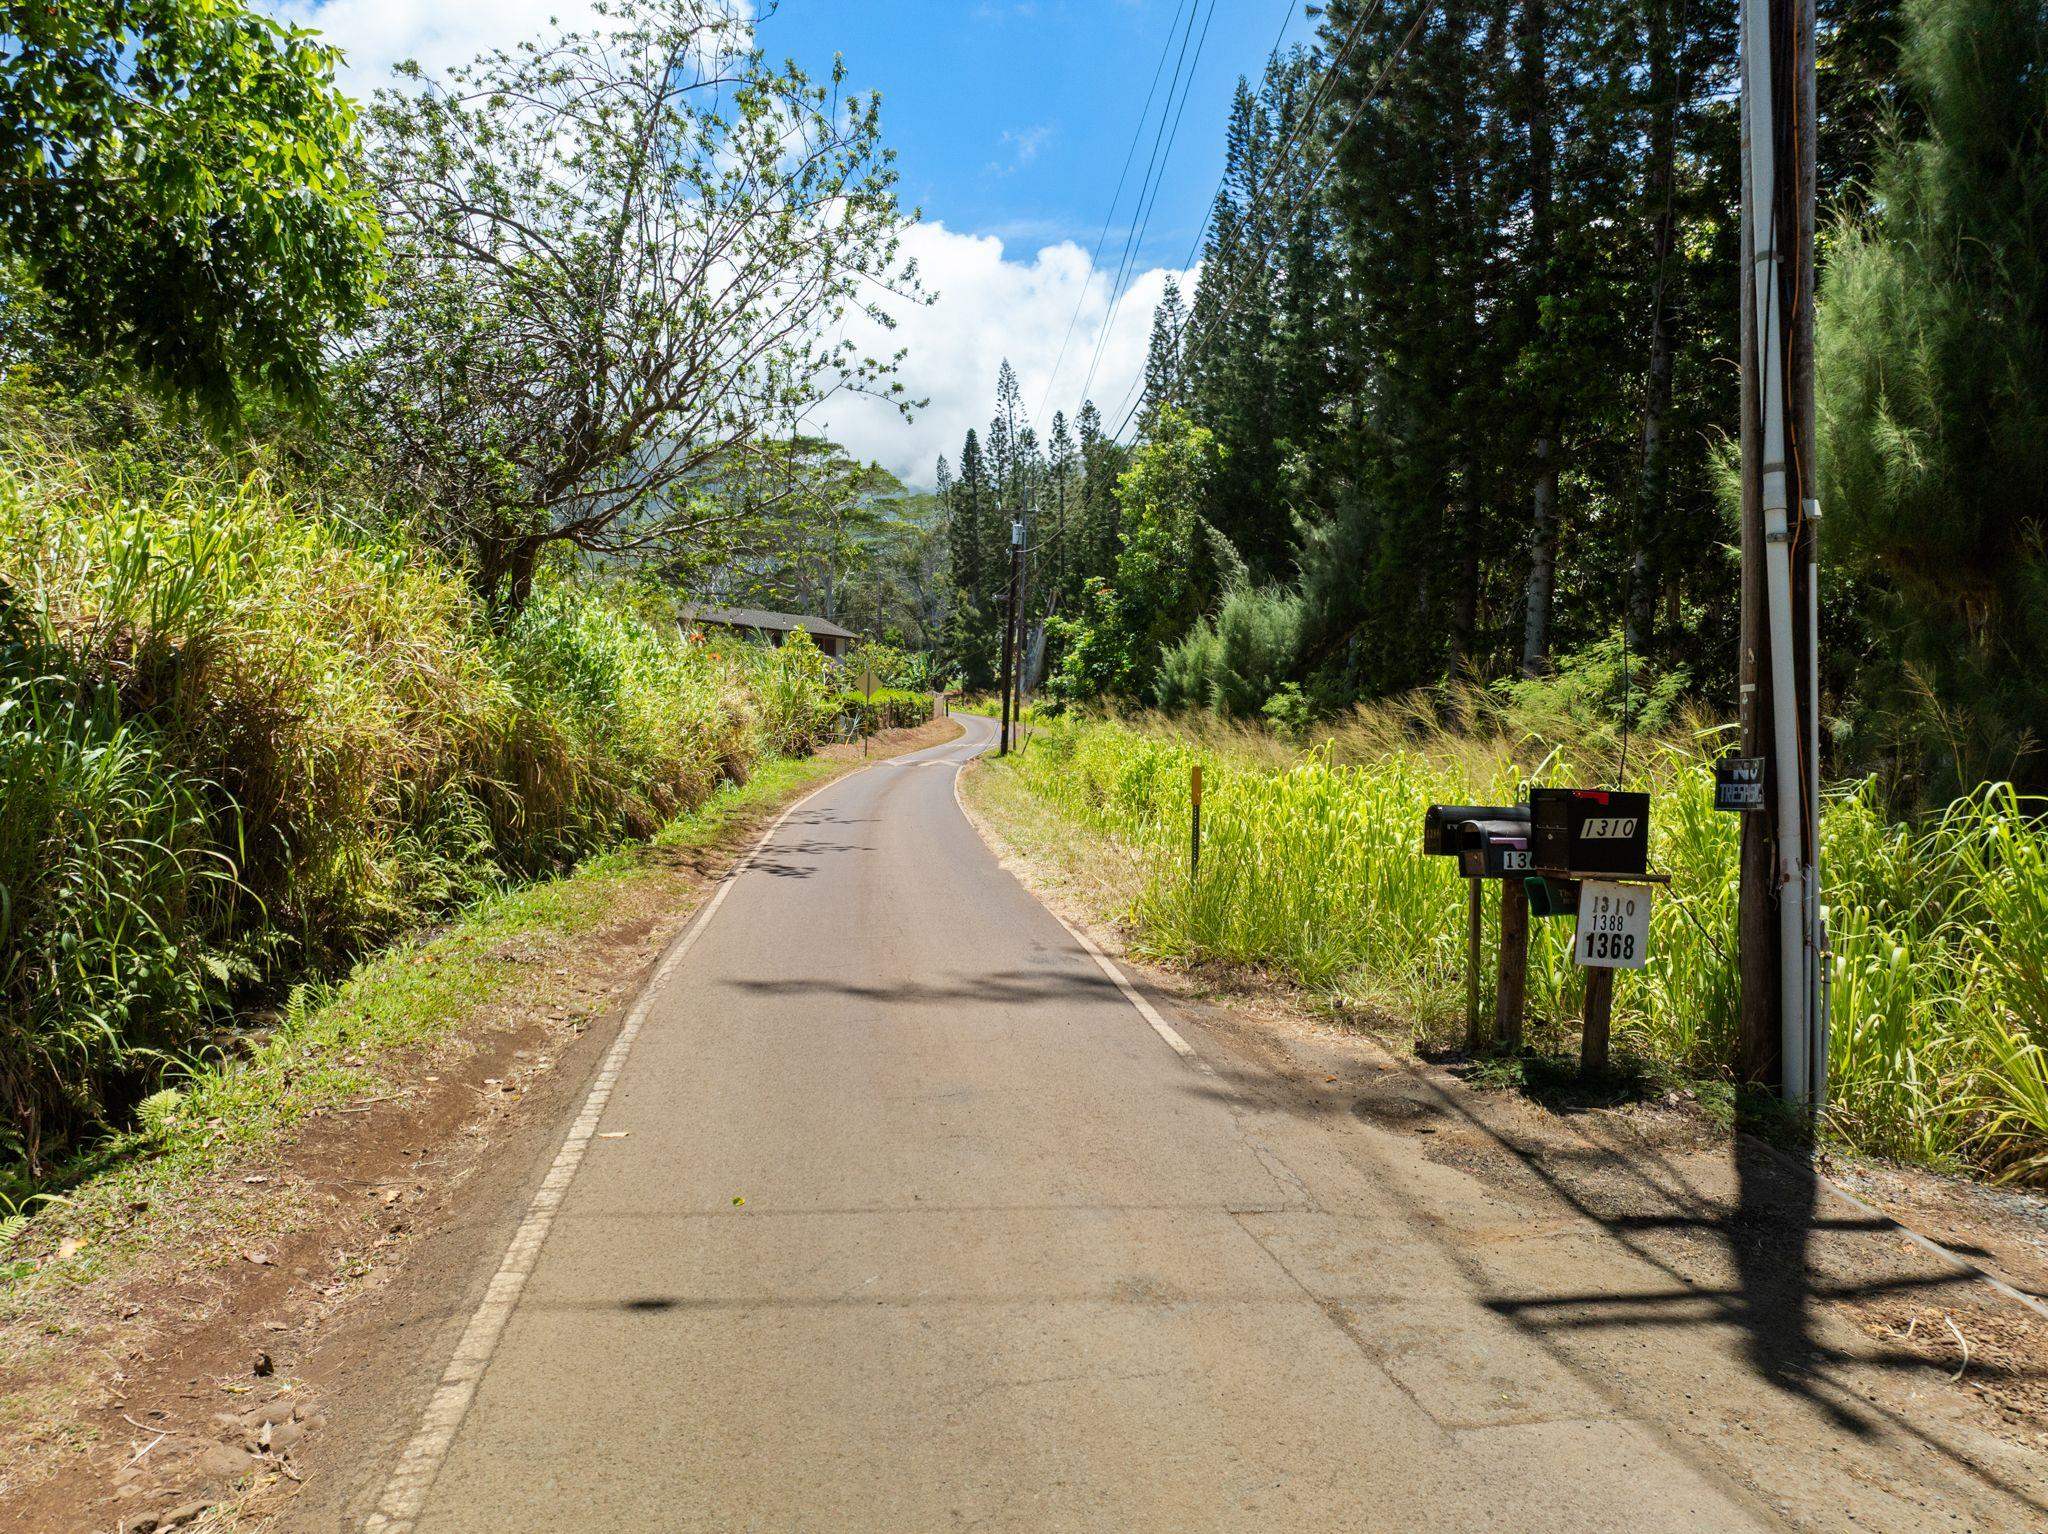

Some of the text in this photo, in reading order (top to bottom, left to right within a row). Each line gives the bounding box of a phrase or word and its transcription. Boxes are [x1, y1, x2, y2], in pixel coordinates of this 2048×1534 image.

[1586, 819, 1634, 837] 1310
[1592, 896, 1635, 917] 1310
[1592, 914, 1623, 931] 1388
[1586, 932, 1635, 960] 1368
